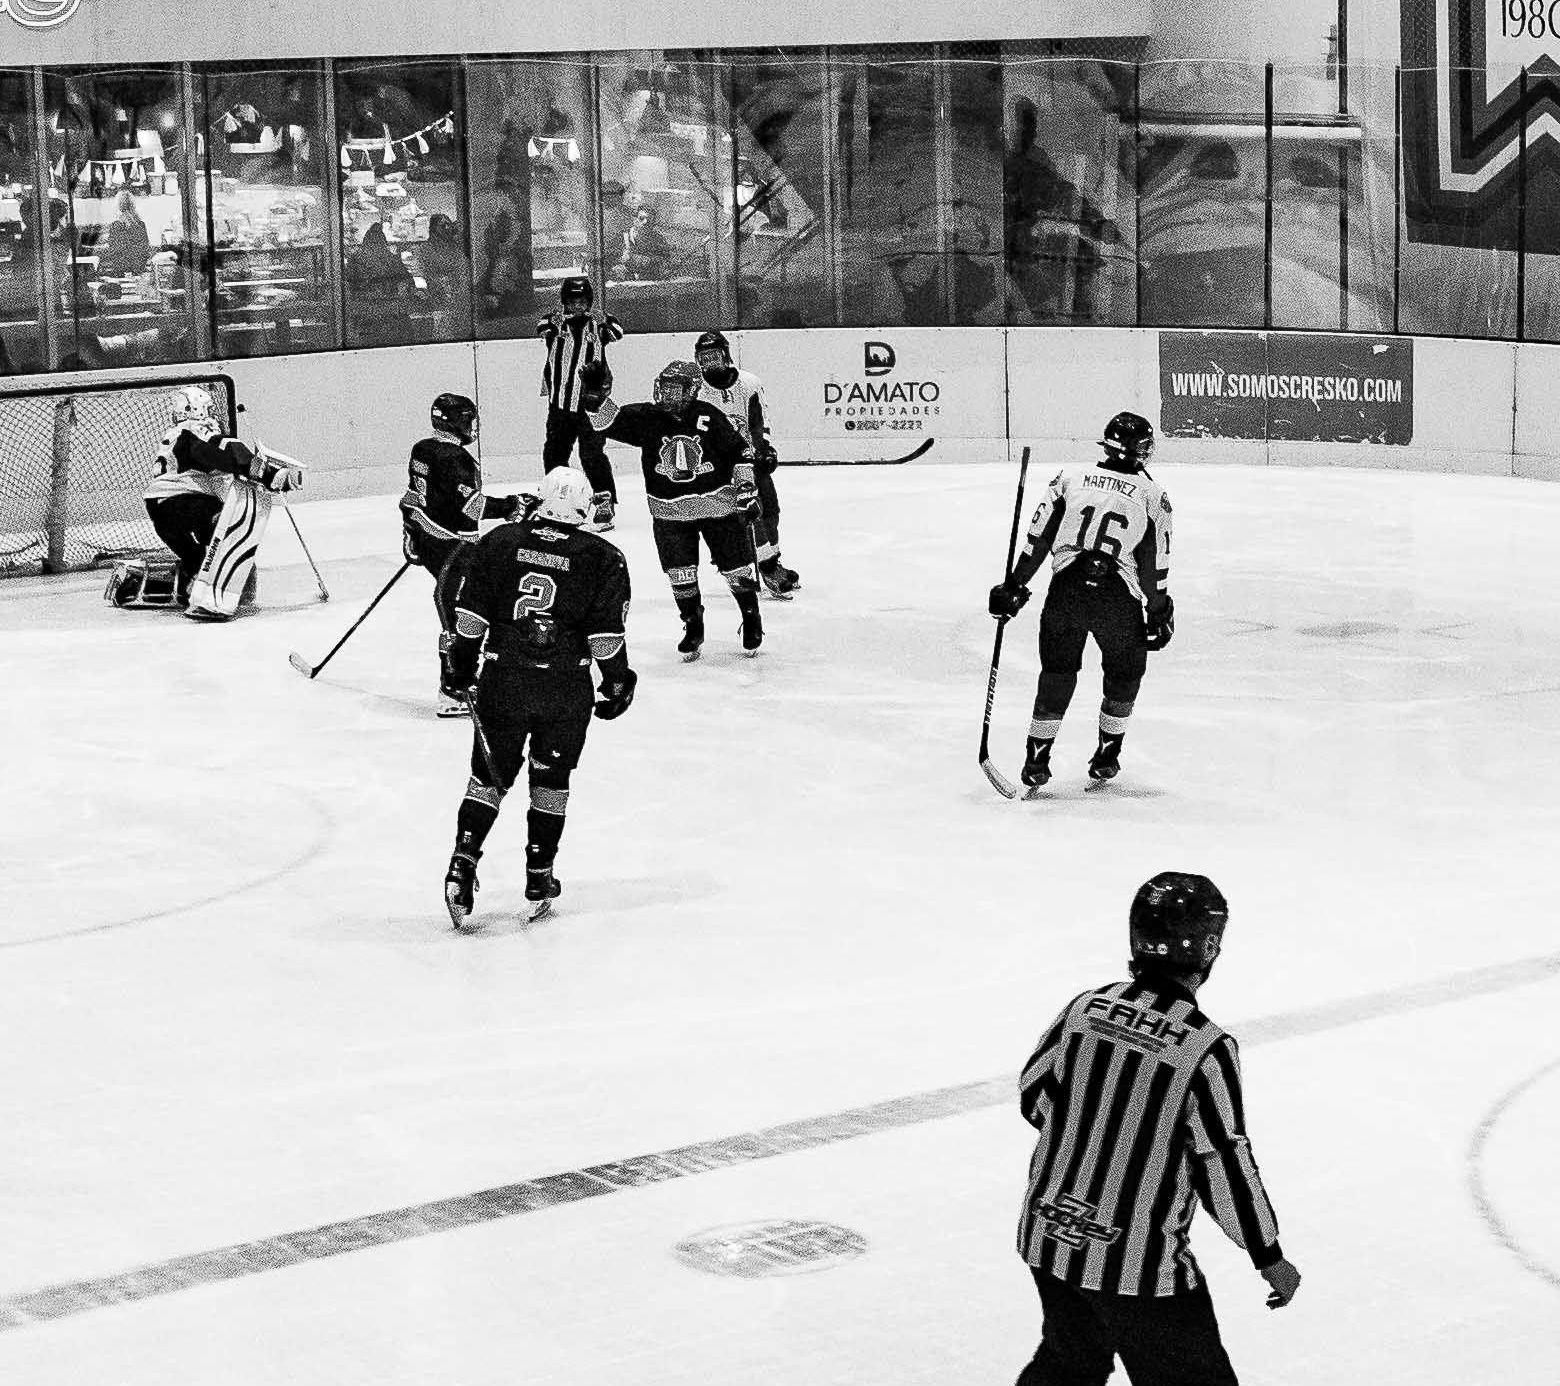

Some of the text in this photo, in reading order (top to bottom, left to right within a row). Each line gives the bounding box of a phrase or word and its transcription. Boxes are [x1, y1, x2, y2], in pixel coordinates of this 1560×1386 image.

[1172, 372, 1402, 403] WWW.SOMOSCRESKO.COM
[824, 406, 940, 416] PROPIEDADES
[1082, 473, 1138, 499] MARTINEZ
[1077, 505, 1130, 560] 16
[513, 571, 558, 621] 2
